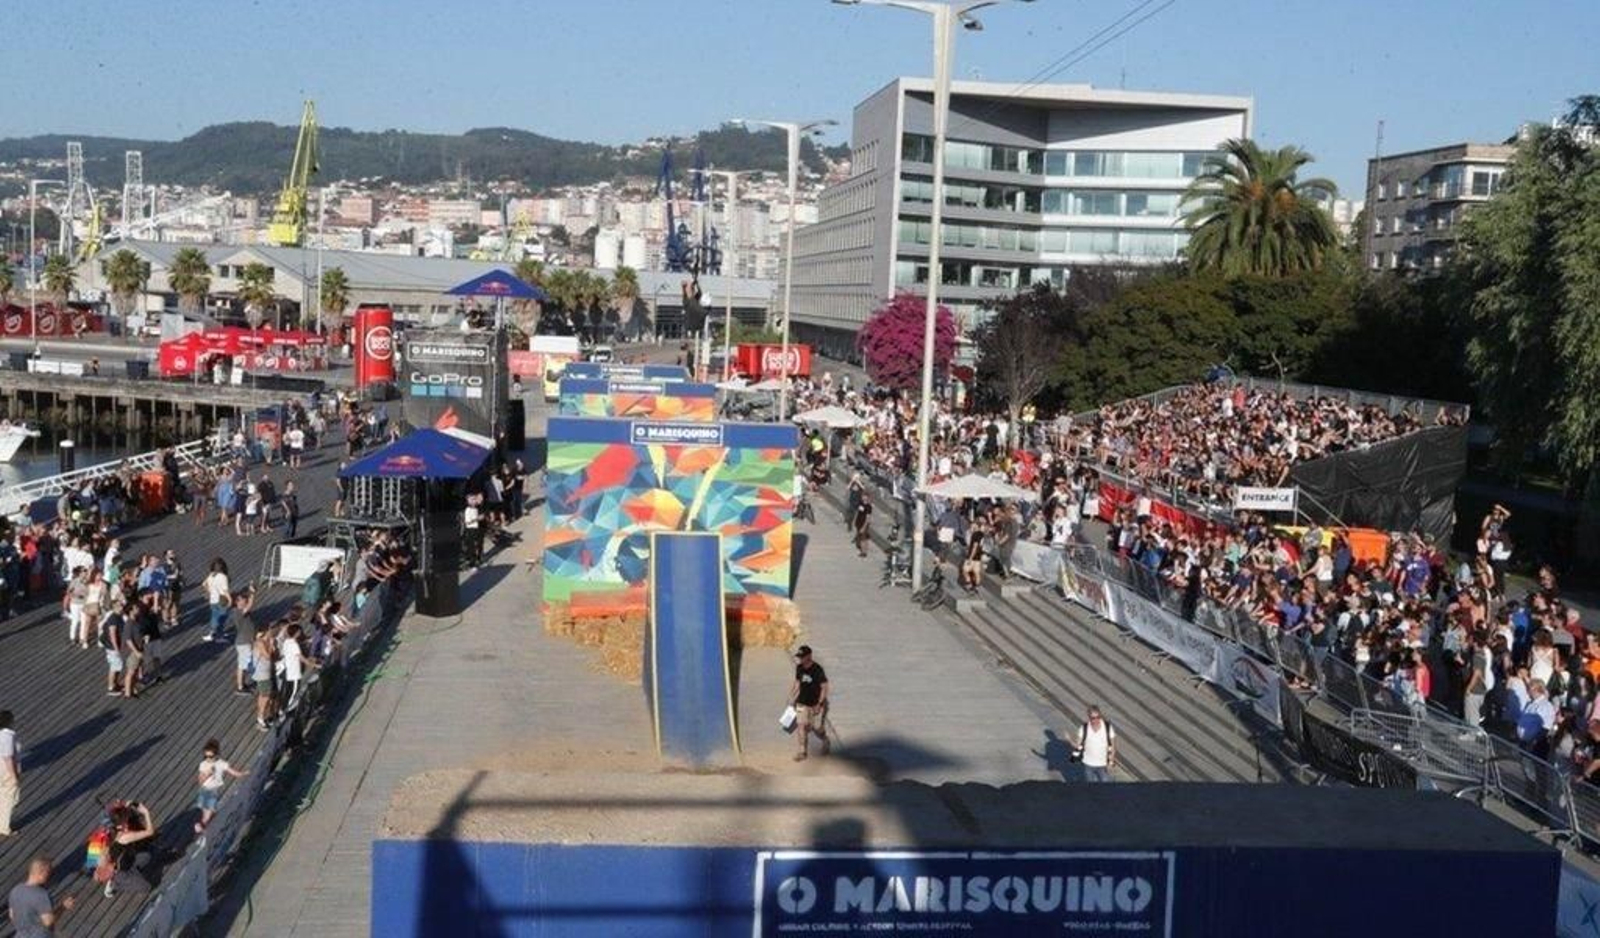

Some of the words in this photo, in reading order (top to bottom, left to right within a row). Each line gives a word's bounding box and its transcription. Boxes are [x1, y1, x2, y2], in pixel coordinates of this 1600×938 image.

[411, 371, 483, 386] GoPro
[635, 427, 646, 436] O
[1241, 494, 1289, 502] ENTRANCE
[777, 876, 817, 914] O
